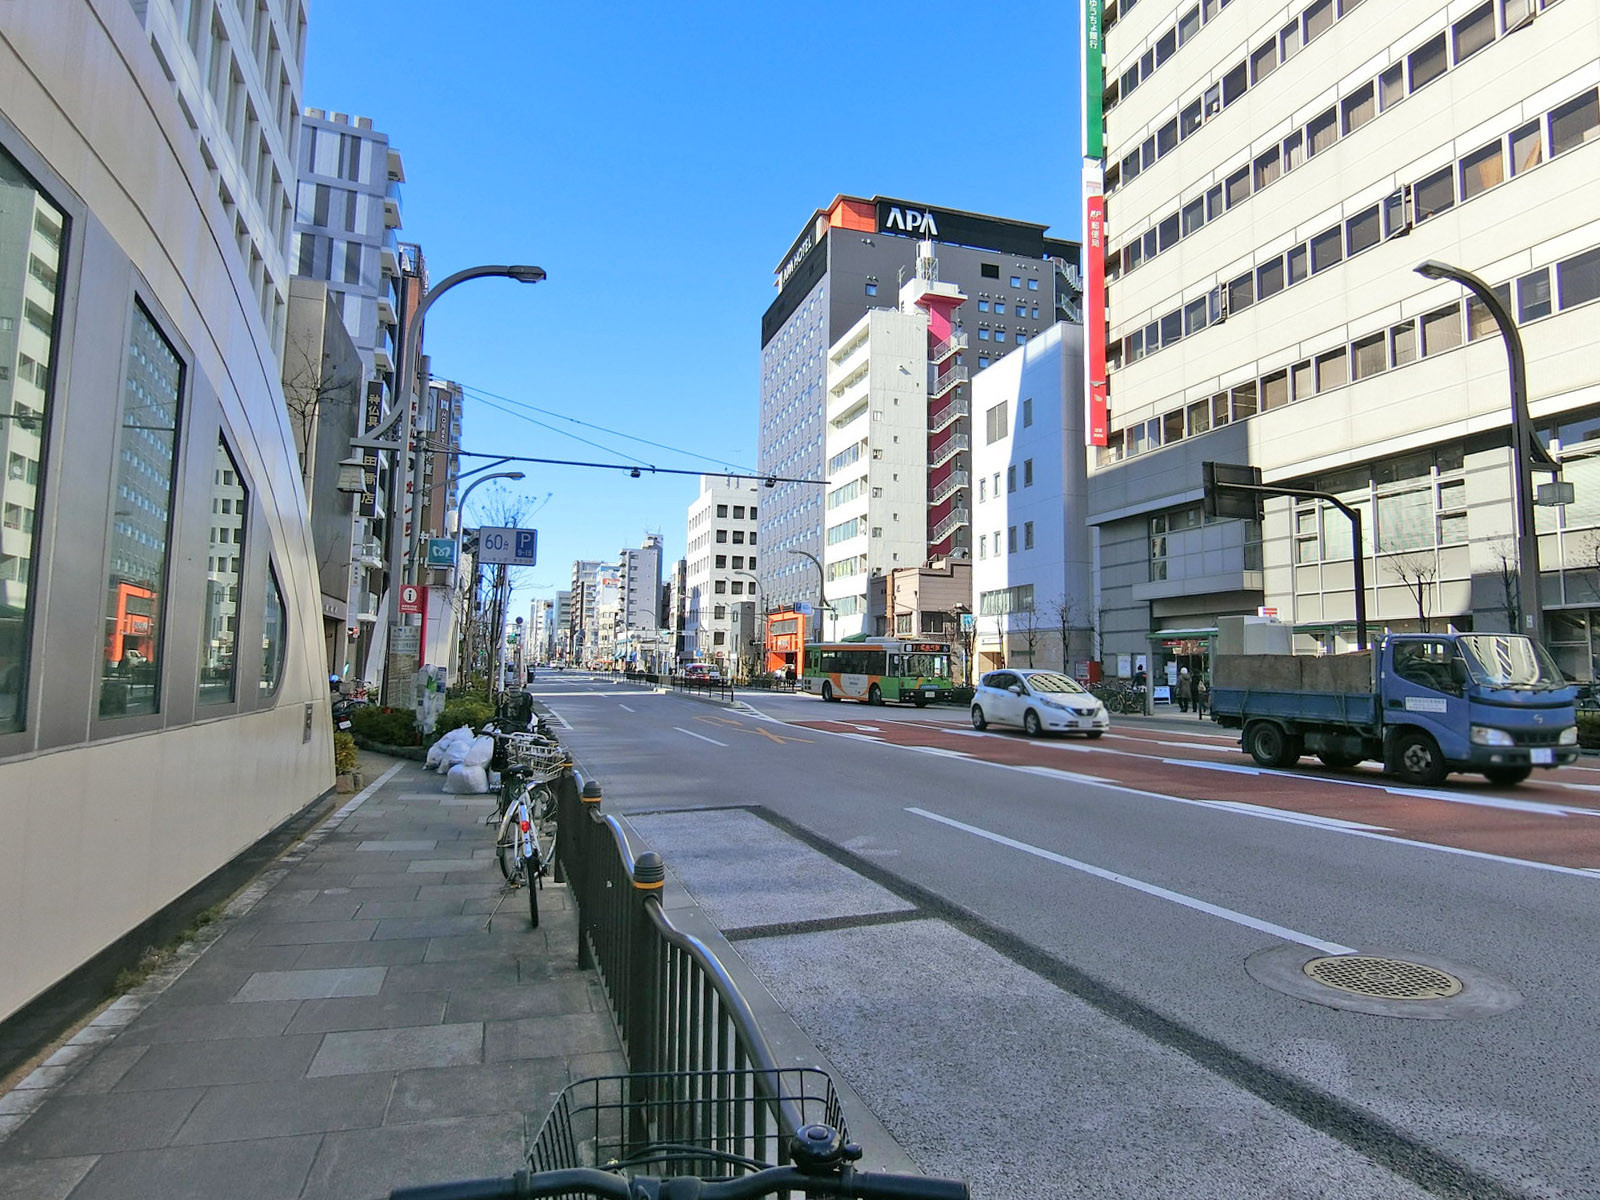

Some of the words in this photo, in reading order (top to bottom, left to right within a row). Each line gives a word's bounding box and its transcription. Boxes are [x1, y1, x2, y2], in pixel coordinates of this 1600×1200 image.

[886, 207, 938, 236] APA
[1091, 221, 1100, 248] 郵便局
[367, 394, 381, 427] 神仏具
[520, 533, 532, 548] P
